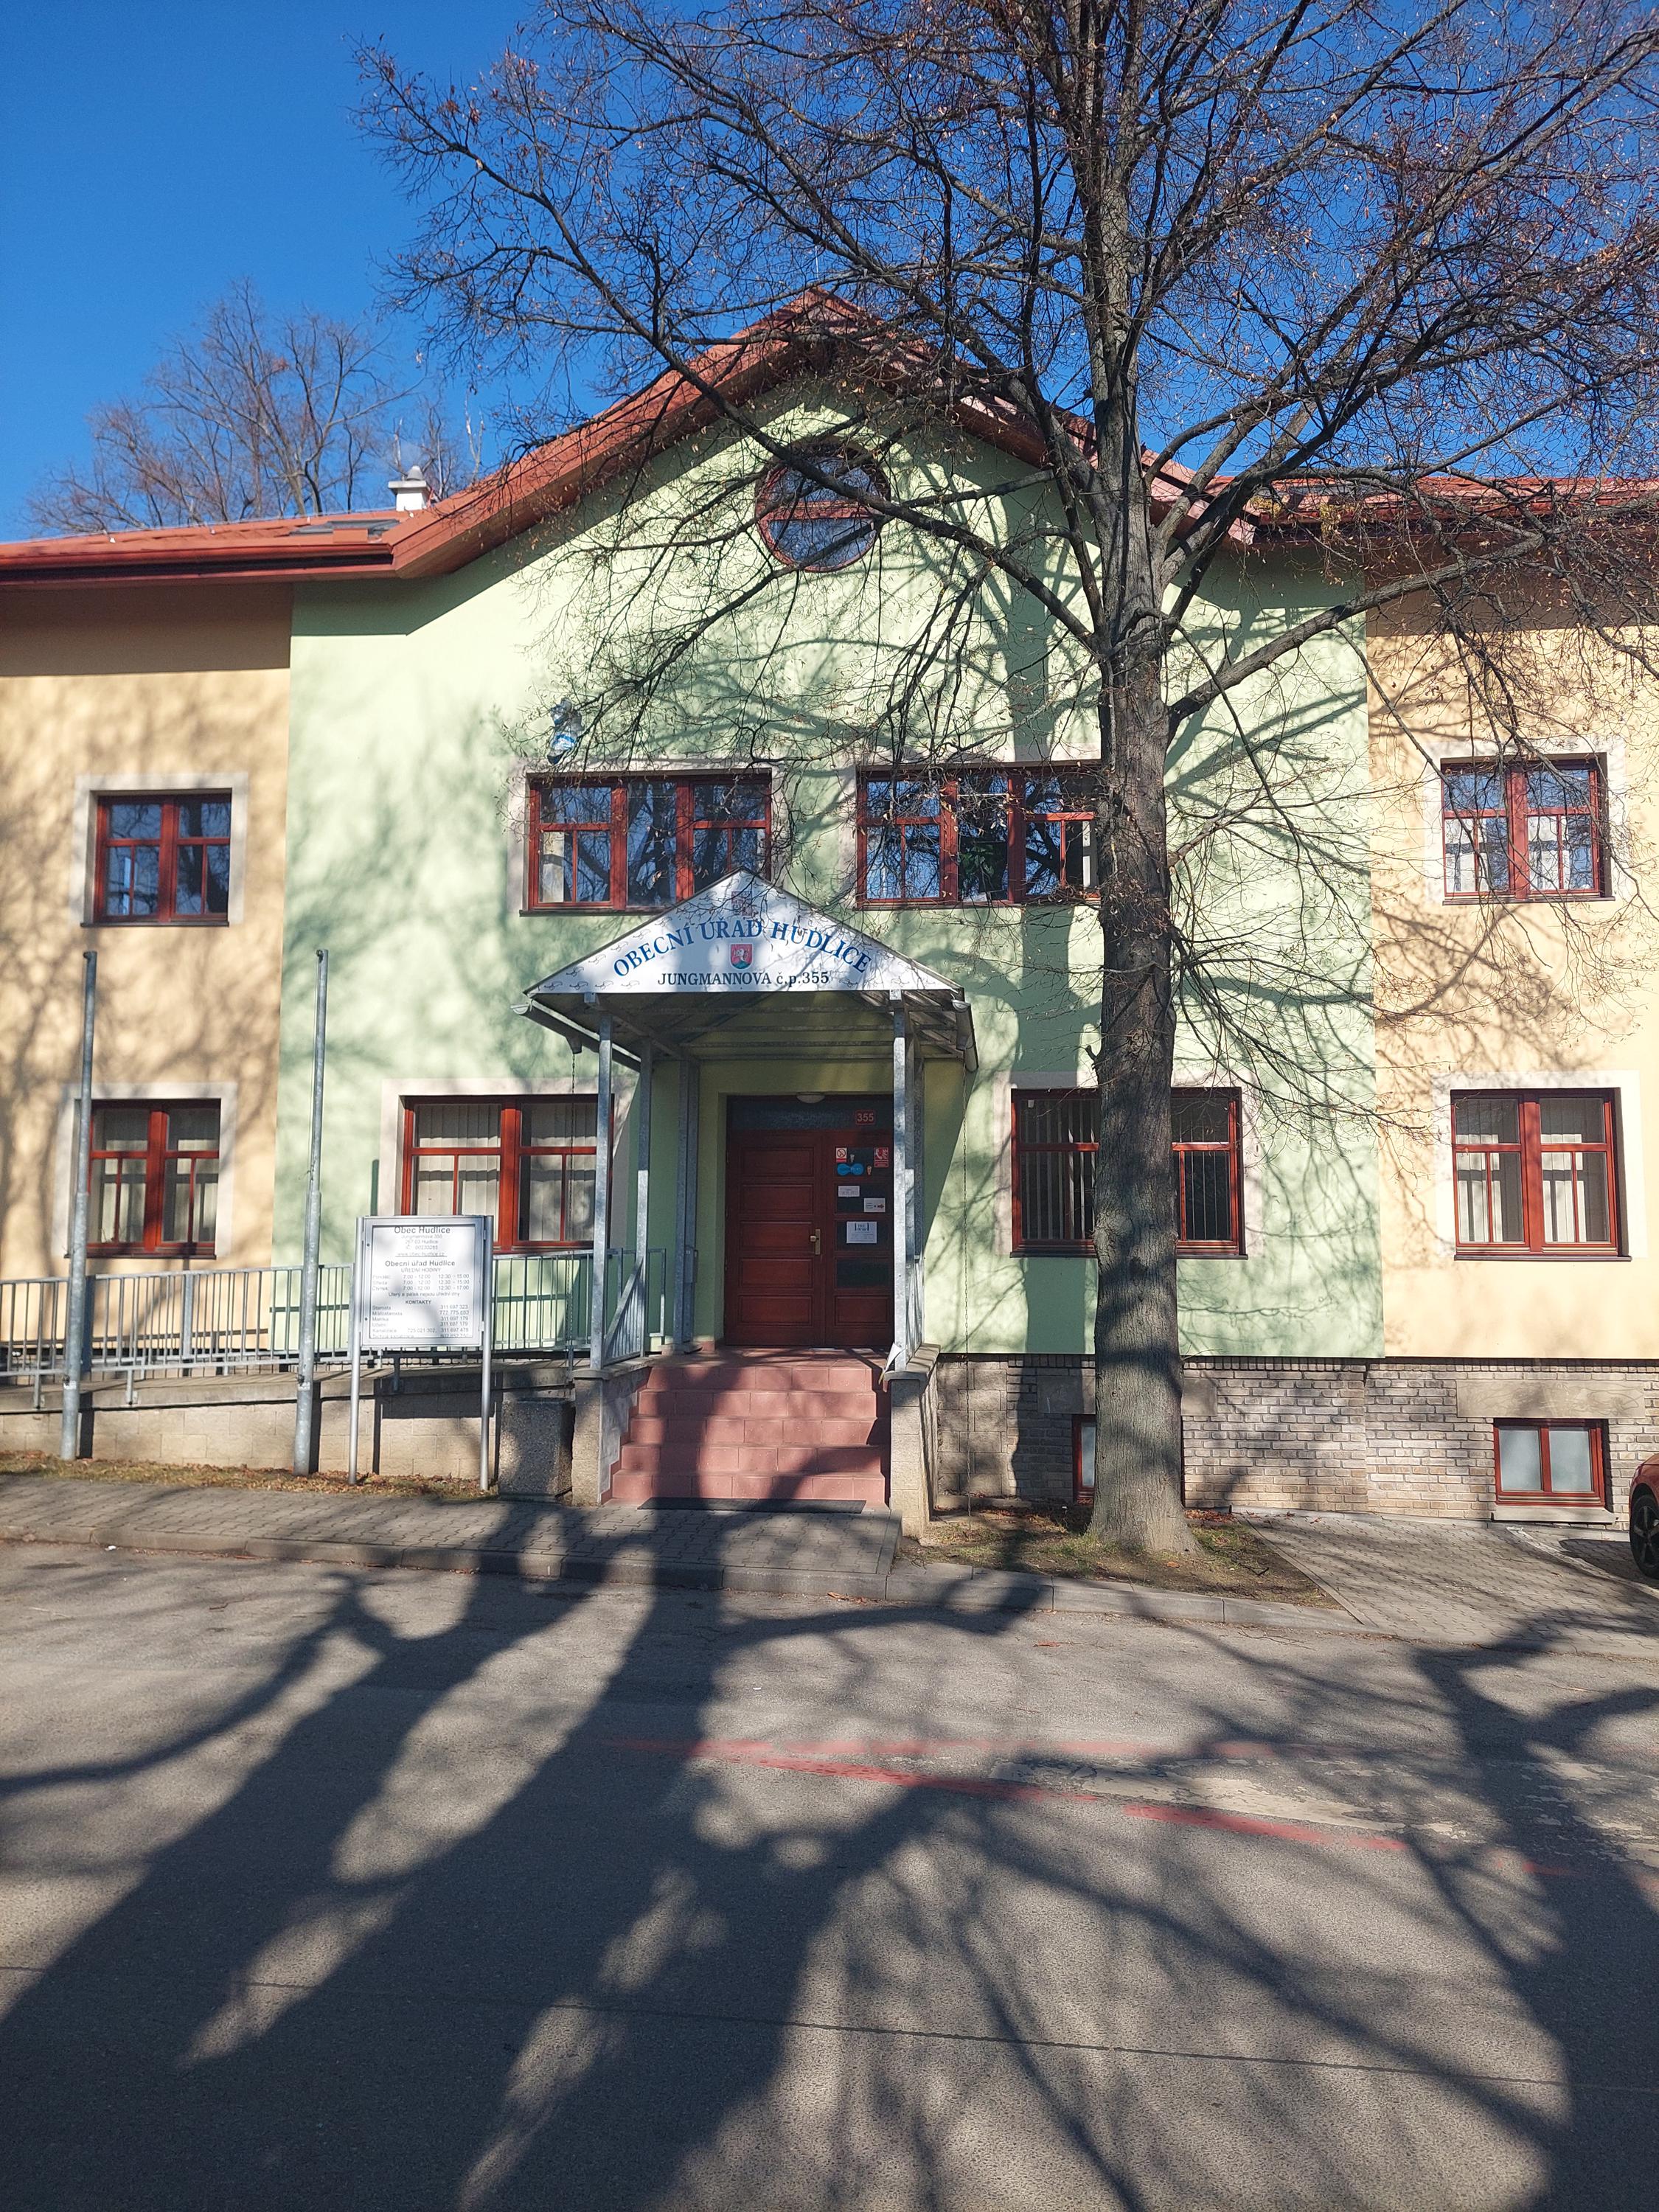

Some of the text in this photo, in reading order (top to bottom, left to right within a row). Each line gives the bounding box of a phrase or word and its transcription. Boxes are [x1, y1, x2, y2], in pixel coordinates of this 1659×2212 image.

[613, 925, 694, 977] OBECNÍ
[771, 922, 872, 974] HUDLICE
[658, 972, 771, 985] JUNGMANNOVA
[857, 1113, 874, 1122] 355
